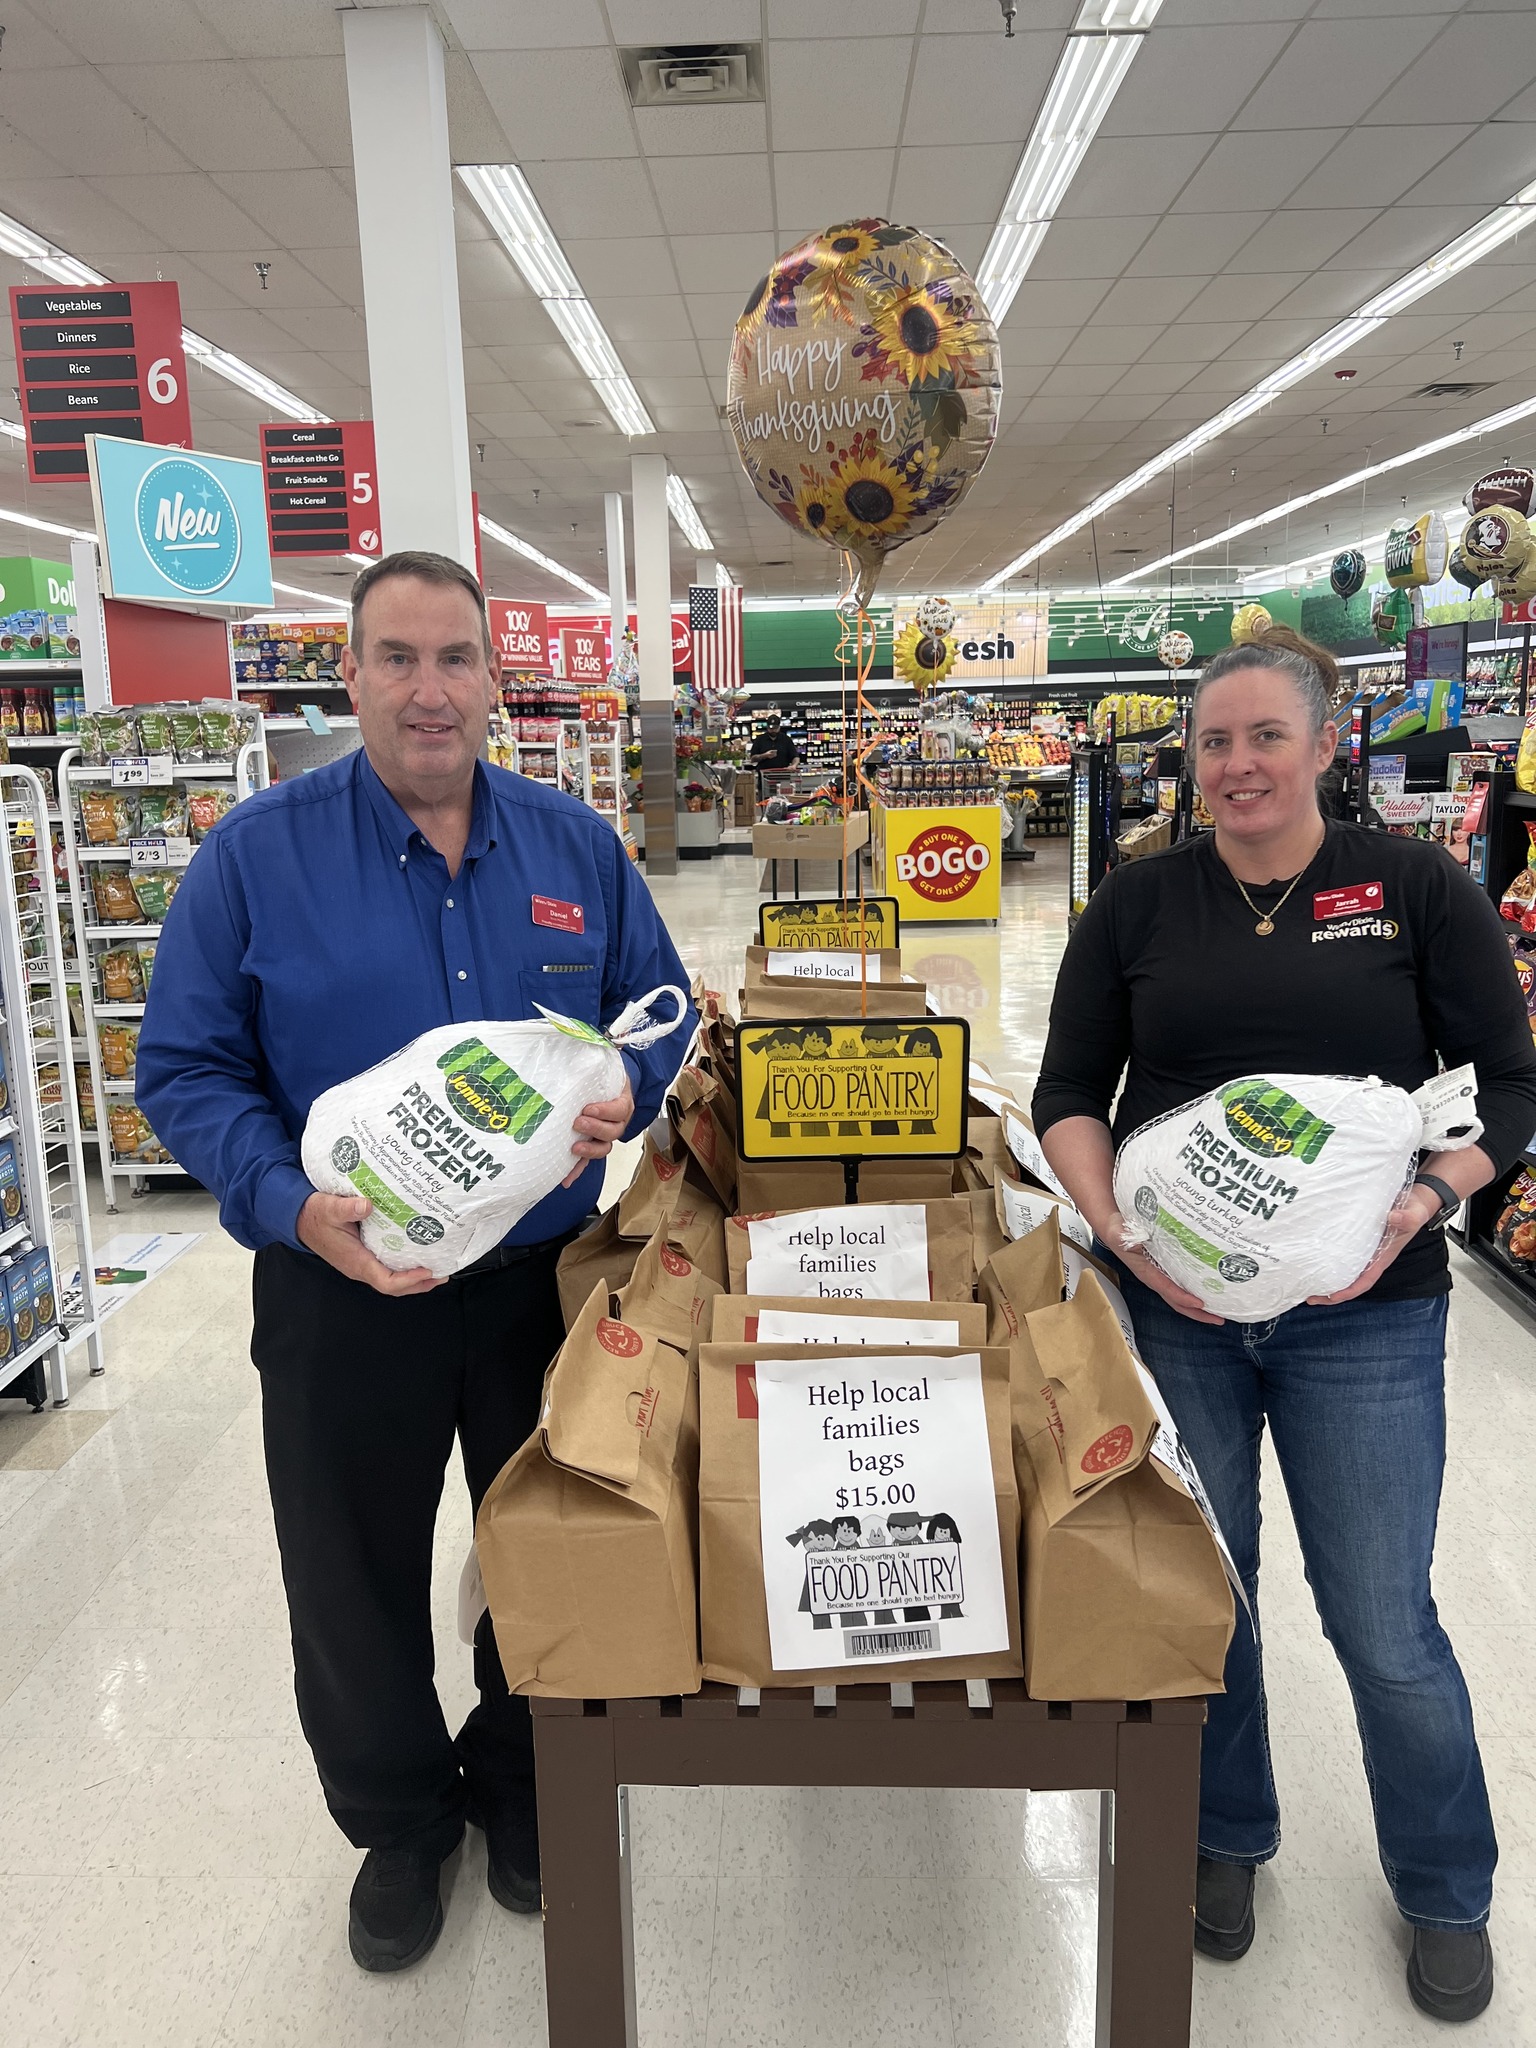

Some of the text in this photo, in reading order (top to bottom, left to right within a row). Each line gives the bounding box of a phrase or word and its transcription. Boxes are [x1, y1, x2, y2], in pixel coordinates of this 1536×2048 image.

[46, 300, 102, 313] Vegetables
[57, 332, 97, 343] Dinners
[69, 363, 91, 374] Rice
[757, 334, 848, 395] Happy
[147, 358, 178, 404] 6
[68, 394, 99, 405] Beans
[732, 390, 901, 453] Thanksgiving
[292, 433, 315, 441] Cereal
[271, 454, 303, 464] Breakfast
[314, 454, 327, 463] the
[328, 454, 339, 462] Go
[285, 475, 328, 484] Fruit Snacks
[352, 472, 373, 504] 5
[290, 496, 326, 505] Hot Cereal
[155, 492, 222, 542] New
[1477, 564, 1505, 573] Noles
[500, 634, 541, 653] YEARS
[672, 633, 690, 650] cal
[961, 633, 1014, 660] esh
[572, 656, 601, 671] YEARS
[1369, 762, 1404, 775] Sudoku!
[1461, 759, 1488, 769] Cross
[1380, 800, 1425, 816] Holiday
[1435, 806, 1466, 814] TAYLOR
[923, 833, 959, 847] BUY ONE
[896, 843, 990, 881] BOGO
[919, 874, 972, 896] GET ONE FREE
[549, 909, 568, 920] Daniel
[782, 930, 880, 948] FOOD PANTRY
[793, 964, 854, 978] Help local
[772, 1066, 795, 1074] Thank
[797, 1065, 810, 1073] You
[828, 1064, 867, 1074] Supporting
[772, 1071, 935, 1111] FOOD PANTRY
[448, 1074, 509, 1129] Jennie-O
[847, 1109, 870, 1117] should
[910, 1108, 935, 1117] hungry.
[402, 1081, 506, 1181] PREMIUM
[387, 1102, 481, 1192] FROZEN
[381, 1134, 445, 1193] young turkey
[1189, 1120, 1299, 1204] PREMIUM
[1176, 1143, 1279, 1221] FROZEN
[1172, 1176, 1206, 1205] young
[1206, 1199, 1244, 1229] turkey
[788, 1225, 886, 1250] Help local
[799, 1253, 877, 1273] families
[819, 1281, 863, 1300] bags
[808, 1377, 930, 1411] Help local
[822, 1414, 920, 1441] families
[848, 1450, 905, 1477] bags
[836, 1483, 916, 1510] $15.00
[809, 1551, 910, 1565] Thank You For Supporting Our
[811, 1555, 957, 1603] FOOD PANTRY
[826, 1601, 854, 1610] Because
[881, 1597, 903, 1606] should
[904, 1597, 913, 1605] go
[923, 1593, 936, 1601] bed
[937, 1591, 961, 1602] hungry.
